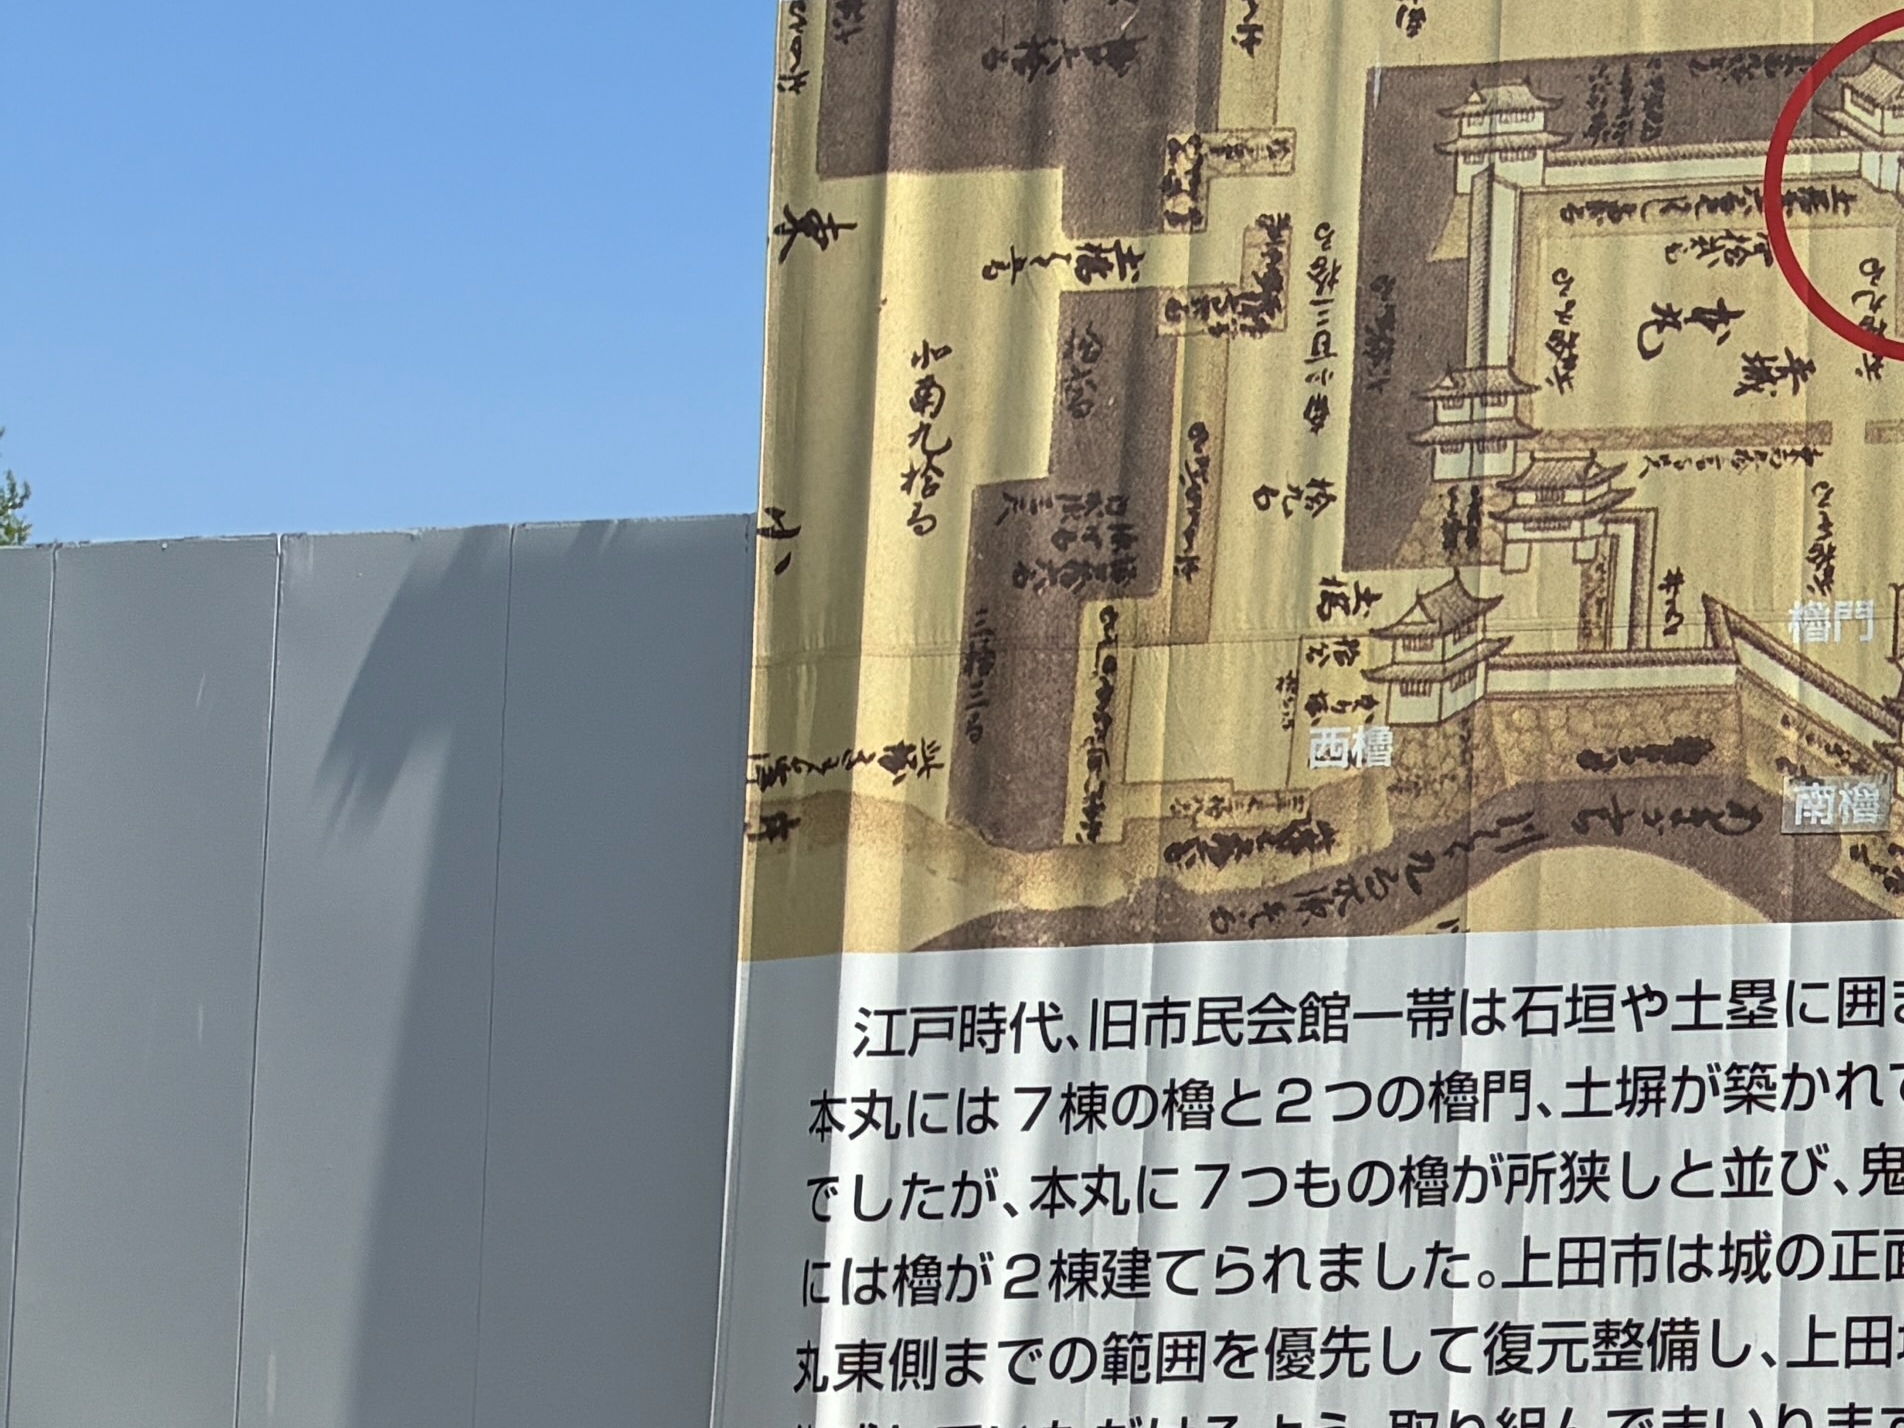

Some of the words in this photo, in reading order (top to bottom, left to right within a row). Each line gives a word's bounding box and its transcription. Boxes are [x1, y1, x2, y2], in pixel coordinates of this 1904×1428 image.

[1788, 600, 1875, 643] 櫓門
[1309, 726, 1394, 768] 西櫓
[1794, 783, 1881, 826] 南櫓
